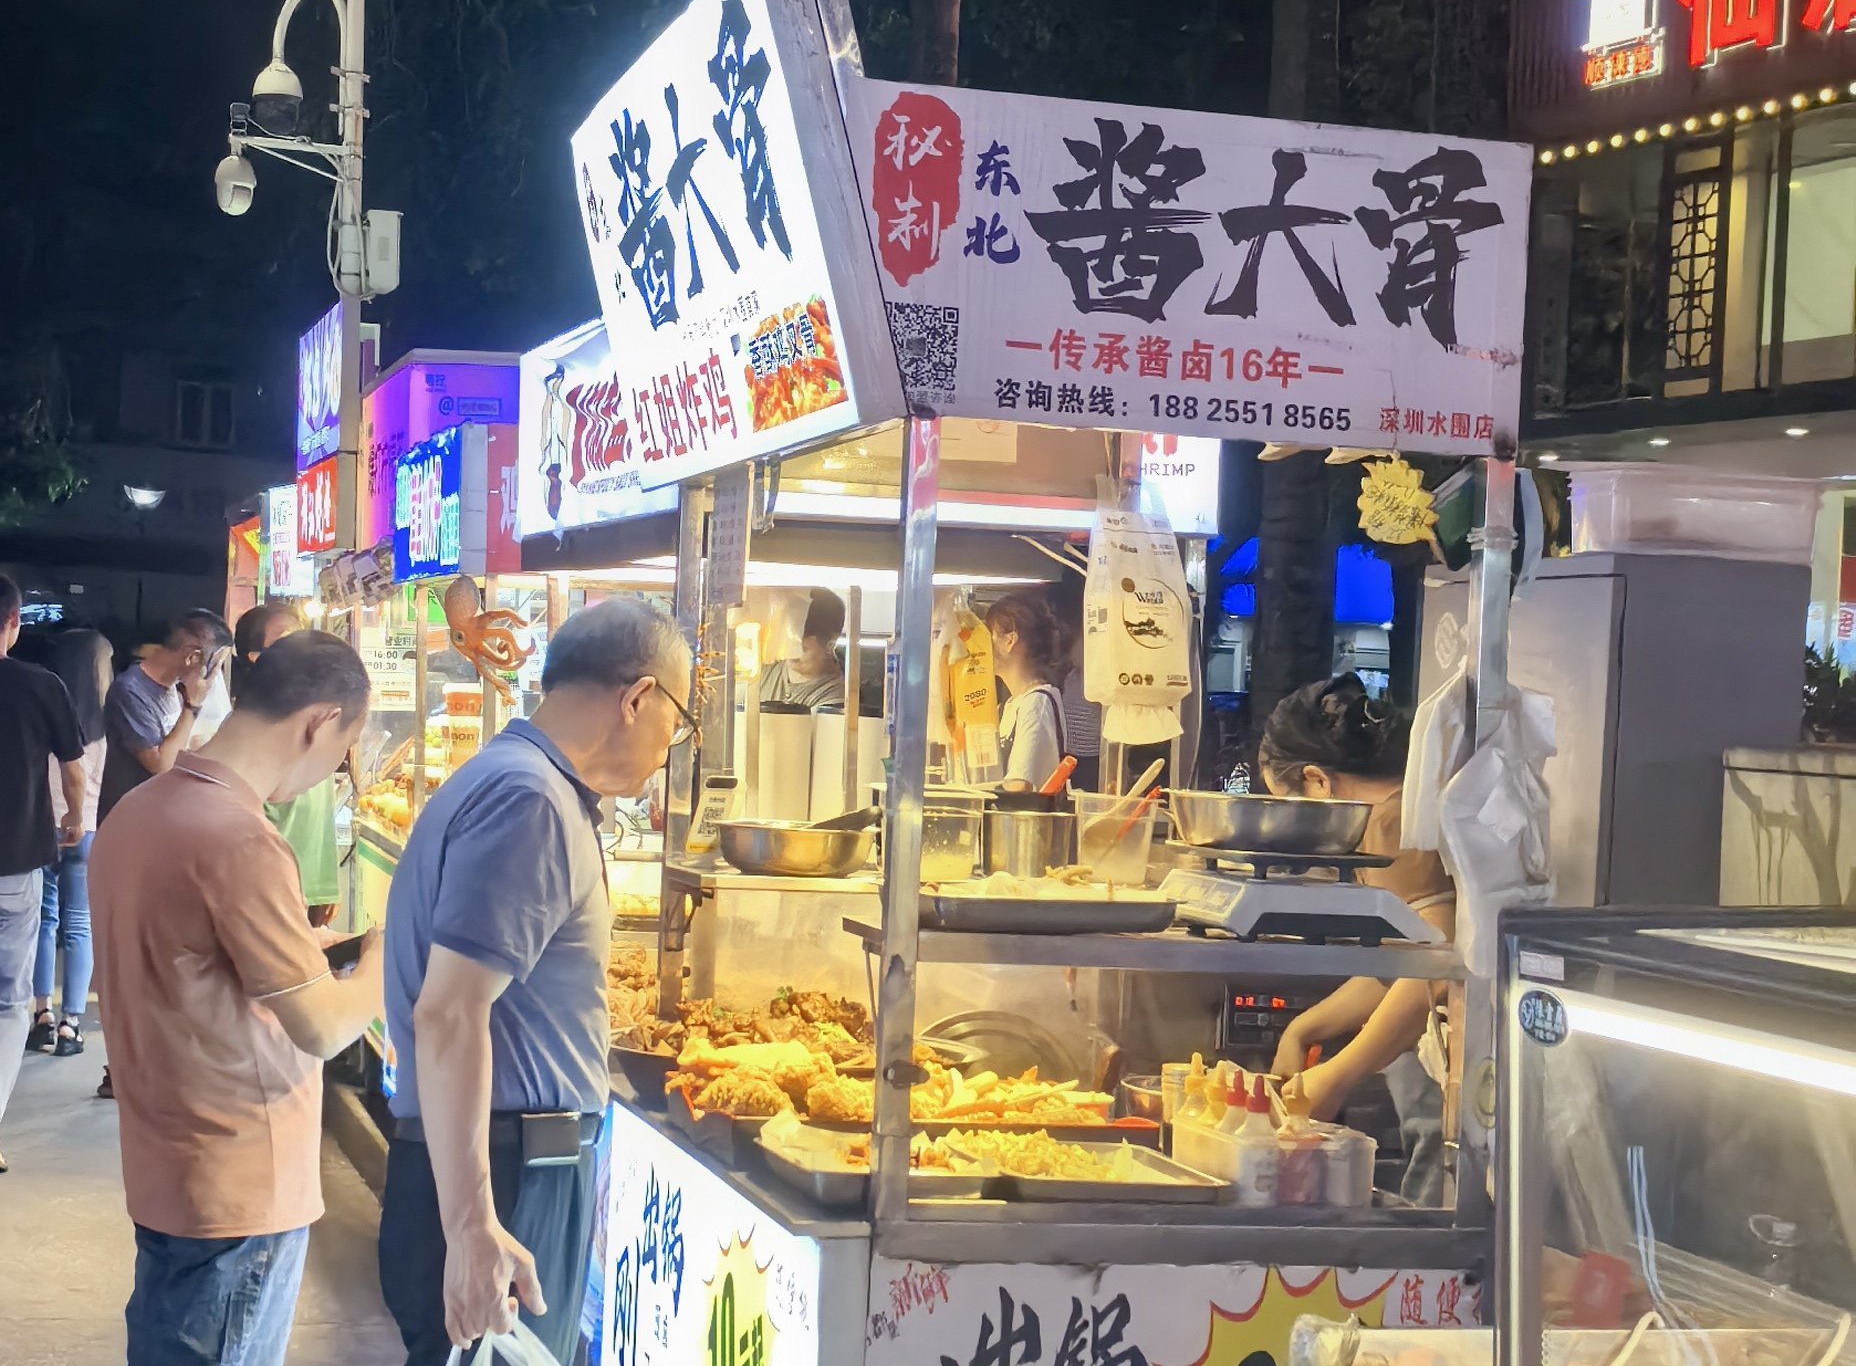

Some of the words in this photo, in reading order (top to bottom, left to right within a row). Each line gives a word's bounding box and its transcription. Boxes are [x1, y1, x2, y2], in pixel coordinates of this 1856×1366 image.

[883, 115, 955, 261] 秘制
[963, 140, 1021, 264] 东北
[1024, 117, 1504, 353] 酱大骨
[632, 347, 738, 462] 红姐炸鸡
[1149, 393, 1199, 420] 188
[1207, 398, 1274, 426] 2551
[1284, 402, 1351, 432] 8565
[1378, 406, 1495, 441] 深圳水围店
[1400, 1274, 1482, 1326] 随便
